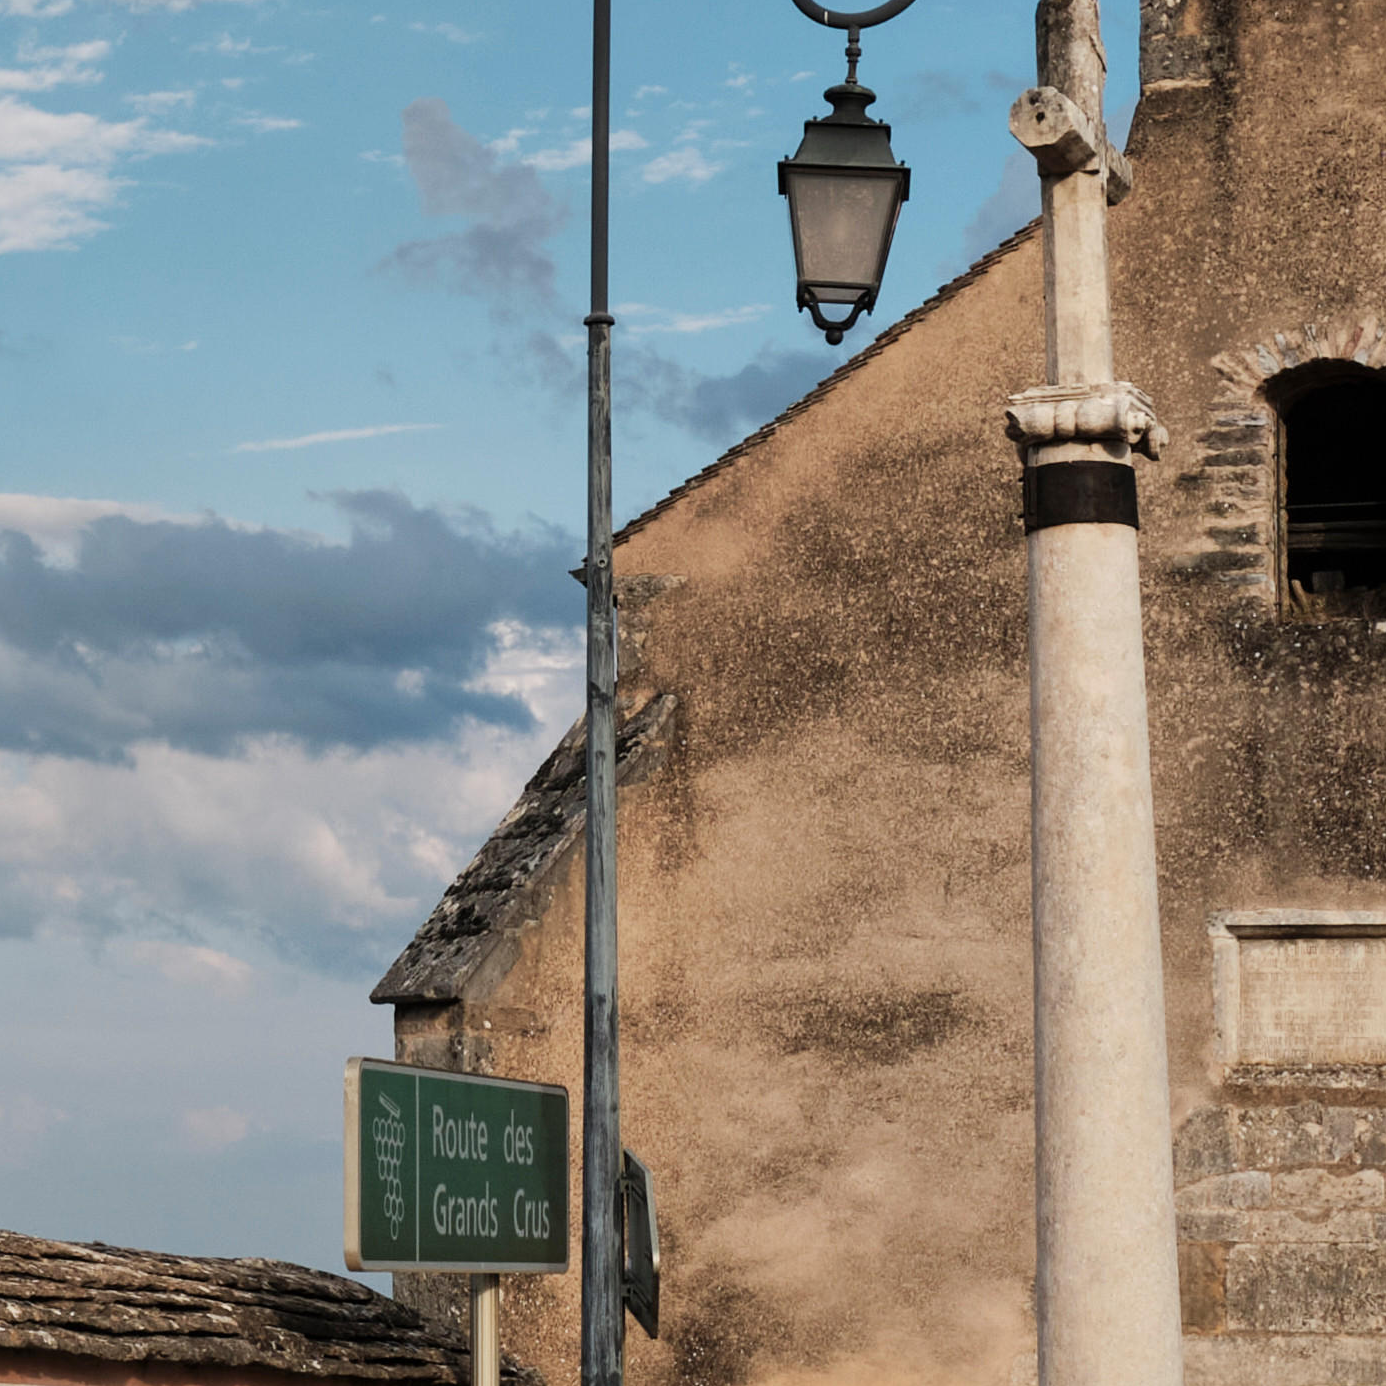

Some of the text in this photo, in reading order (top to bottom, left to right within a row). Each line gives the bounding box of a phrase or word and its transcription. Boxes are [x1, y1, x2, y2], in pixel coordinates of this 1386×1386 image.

[432, 1104, 534, 1165] Route des
[433, 1181, 551, 1240] Grands Crus
